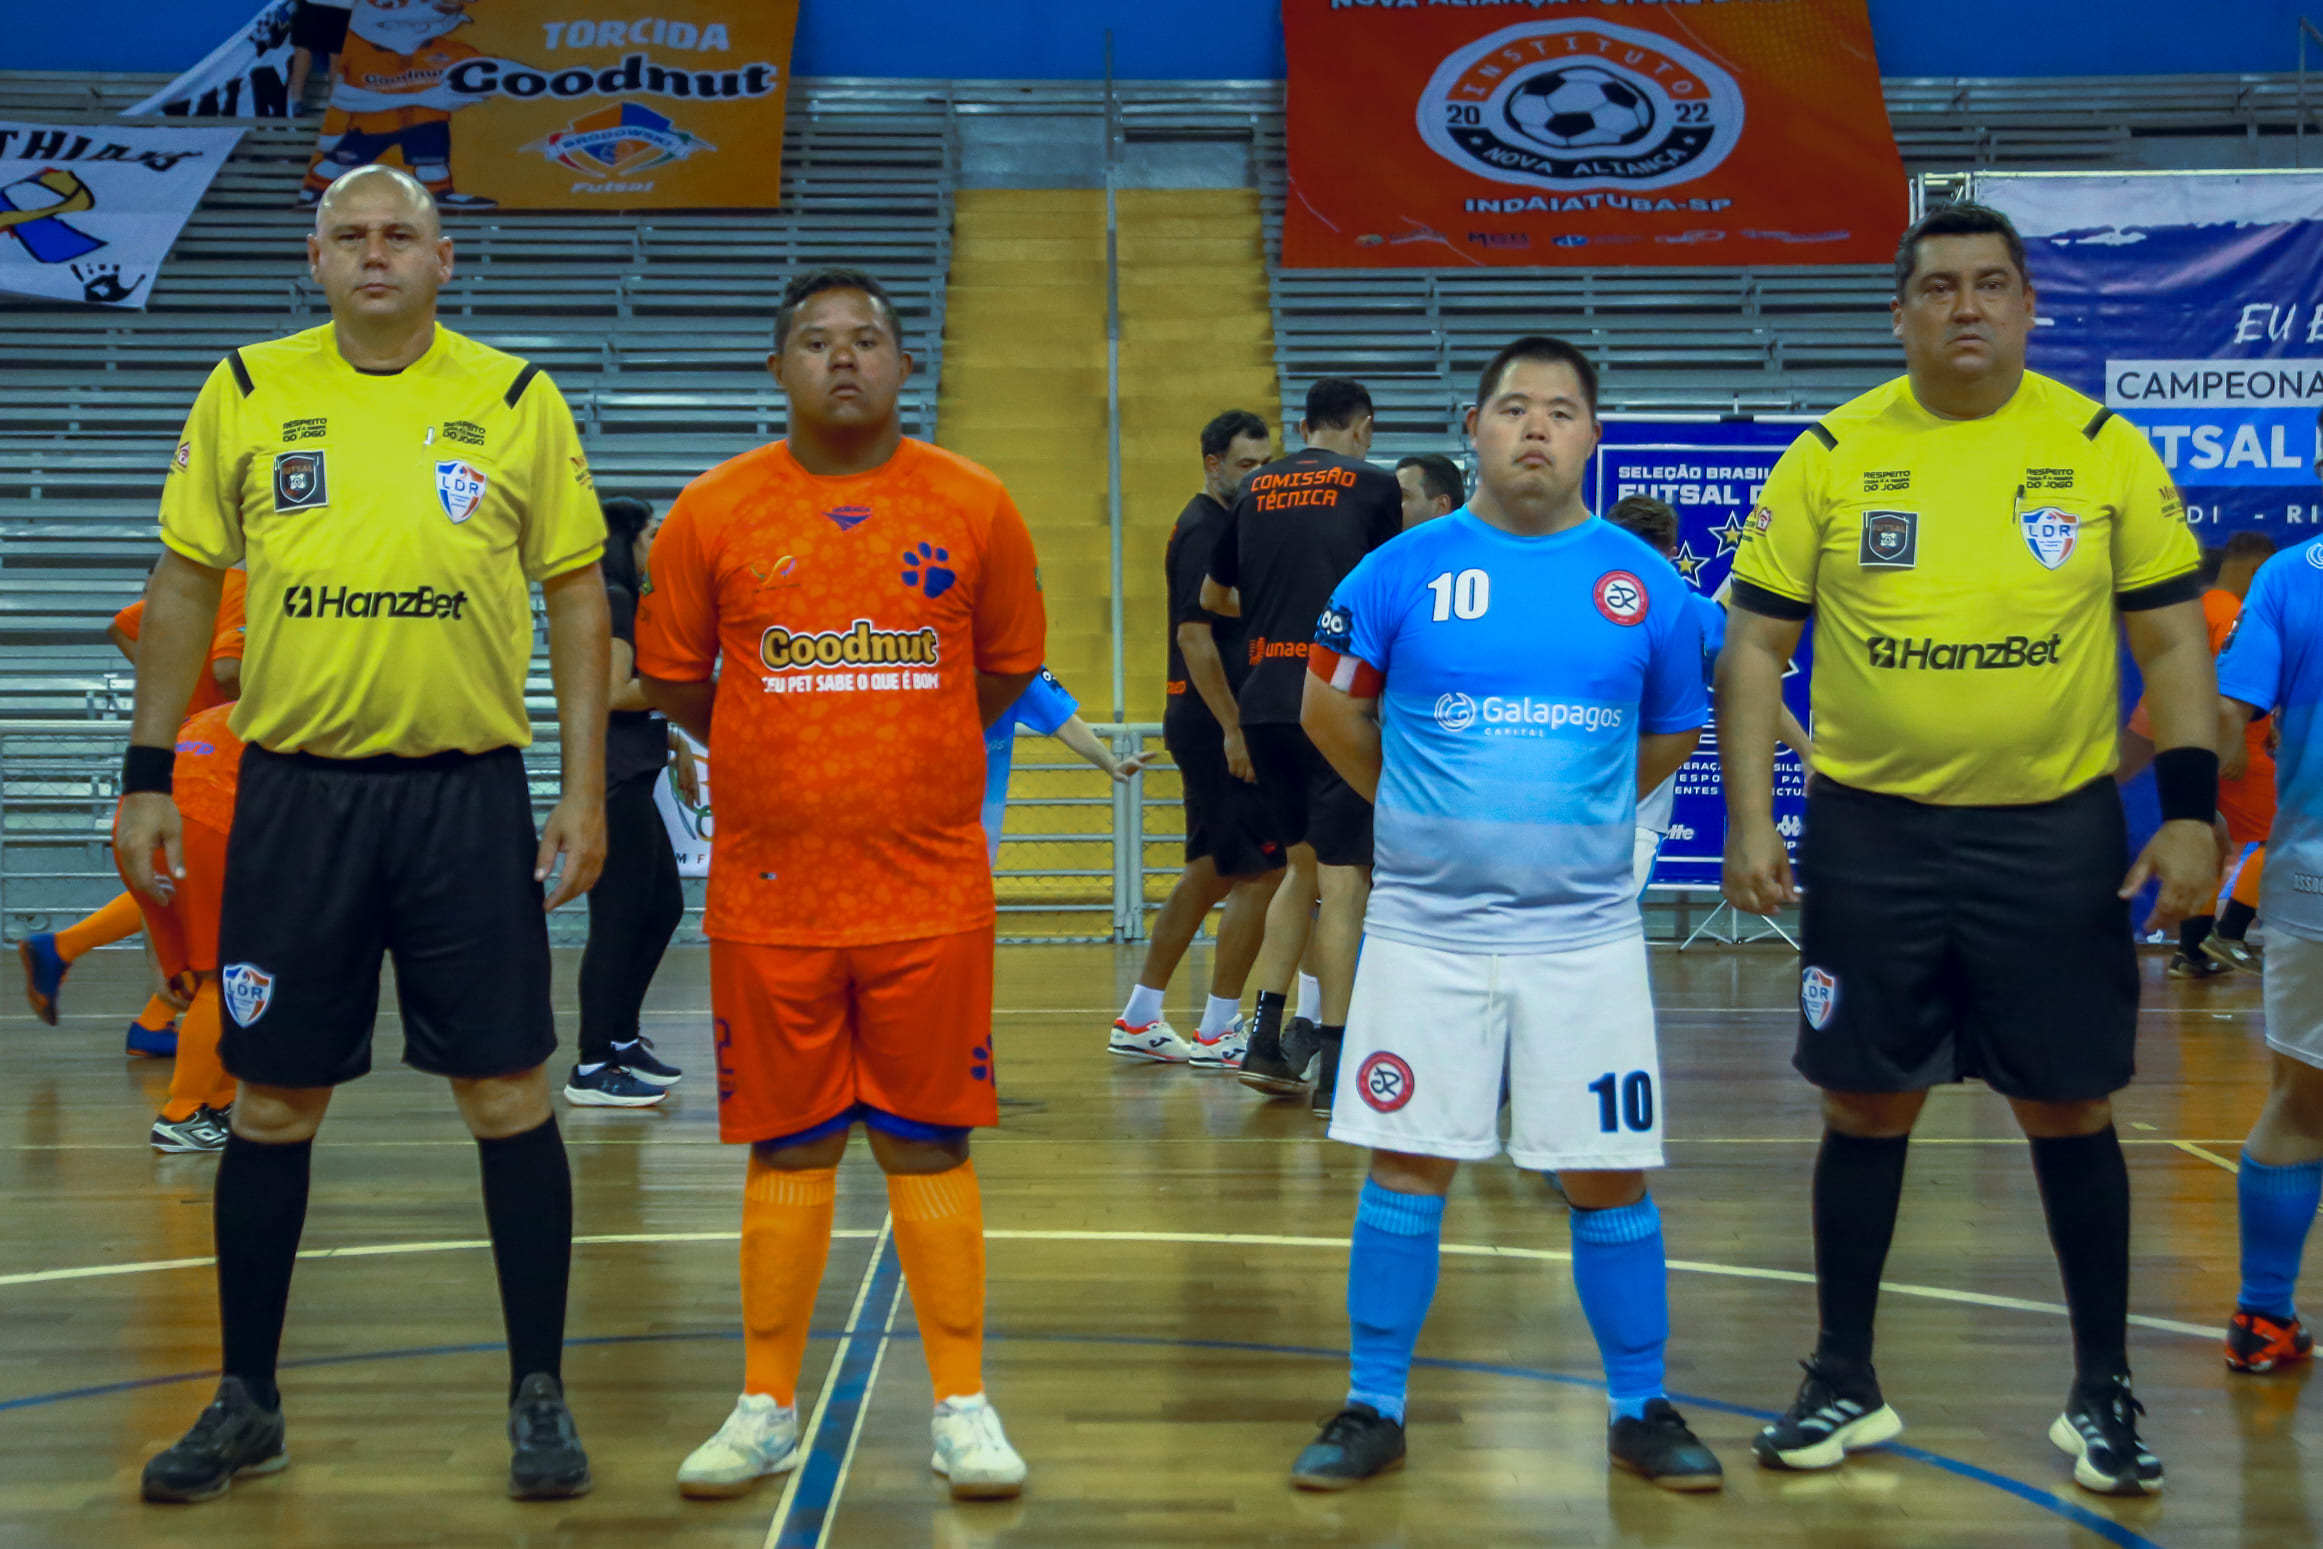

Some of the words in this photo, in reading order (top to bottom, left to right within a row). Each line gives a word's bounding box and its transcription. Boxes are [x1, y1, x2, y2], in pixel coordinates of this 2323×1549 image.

[543, 17, 730, 51] TORCIDA
[447, 54, 777, 99] Goodnut
[1463, 36, 1695, 97] INSTITUTO
[1446, 104, 1481, 126] 20
[1675, 102, 1710, 123] 22
[1483, 147, 1553, 174] NOVA
[1572, 148, 1689, 175] ALIANÇA
[1464, 194, 1733, 213] INDAIATUBA-SP
[2233, 303, 2297, 344] EU
[2116, 370, 2323, 400] CAMPEONA
[2138, 424, 2302, 470] TSAL
[442, 475, 479, 496] LDR
[1250, 466, 1357, 492] COMISSÃO
[1618, 464, 1701, 482] SELEÇÃO
[1863, 470, 1911, 479] RESPEITO
[1256, 489, 1339, 512] TÉCNICA
[2028, 524, 2071, 538] LDR
[316, 585, 468, 621] HanzBet
[1426, 568, 1491, 623] 10
[760, 617, 939, 672] Goodnut
[1265, 641, 1309, 658] unae
[1901, 633, 2063, 671] HanzBet
[788, 675, 813, 693] PET
[816, 673, 854, 692] SABE
[856, 673, 868, 691] O
[871, 673, 900, 690] QUE
[902, 670, 911, 689] É
[912, 673, 939, 689] BOM
[1482, 696, 1623, 733] Galapagos
[1484, 727, 1545, 738] CAPITAL
[1678, 762, 1721, 773] ERAÇ
[1674, 786, 1718, 795] ENTES
[1772, 787, 1806, 797] CTU
[1802, 985, 1829, 1001] DR
[1587, 1069, 1654, 1133] 10
